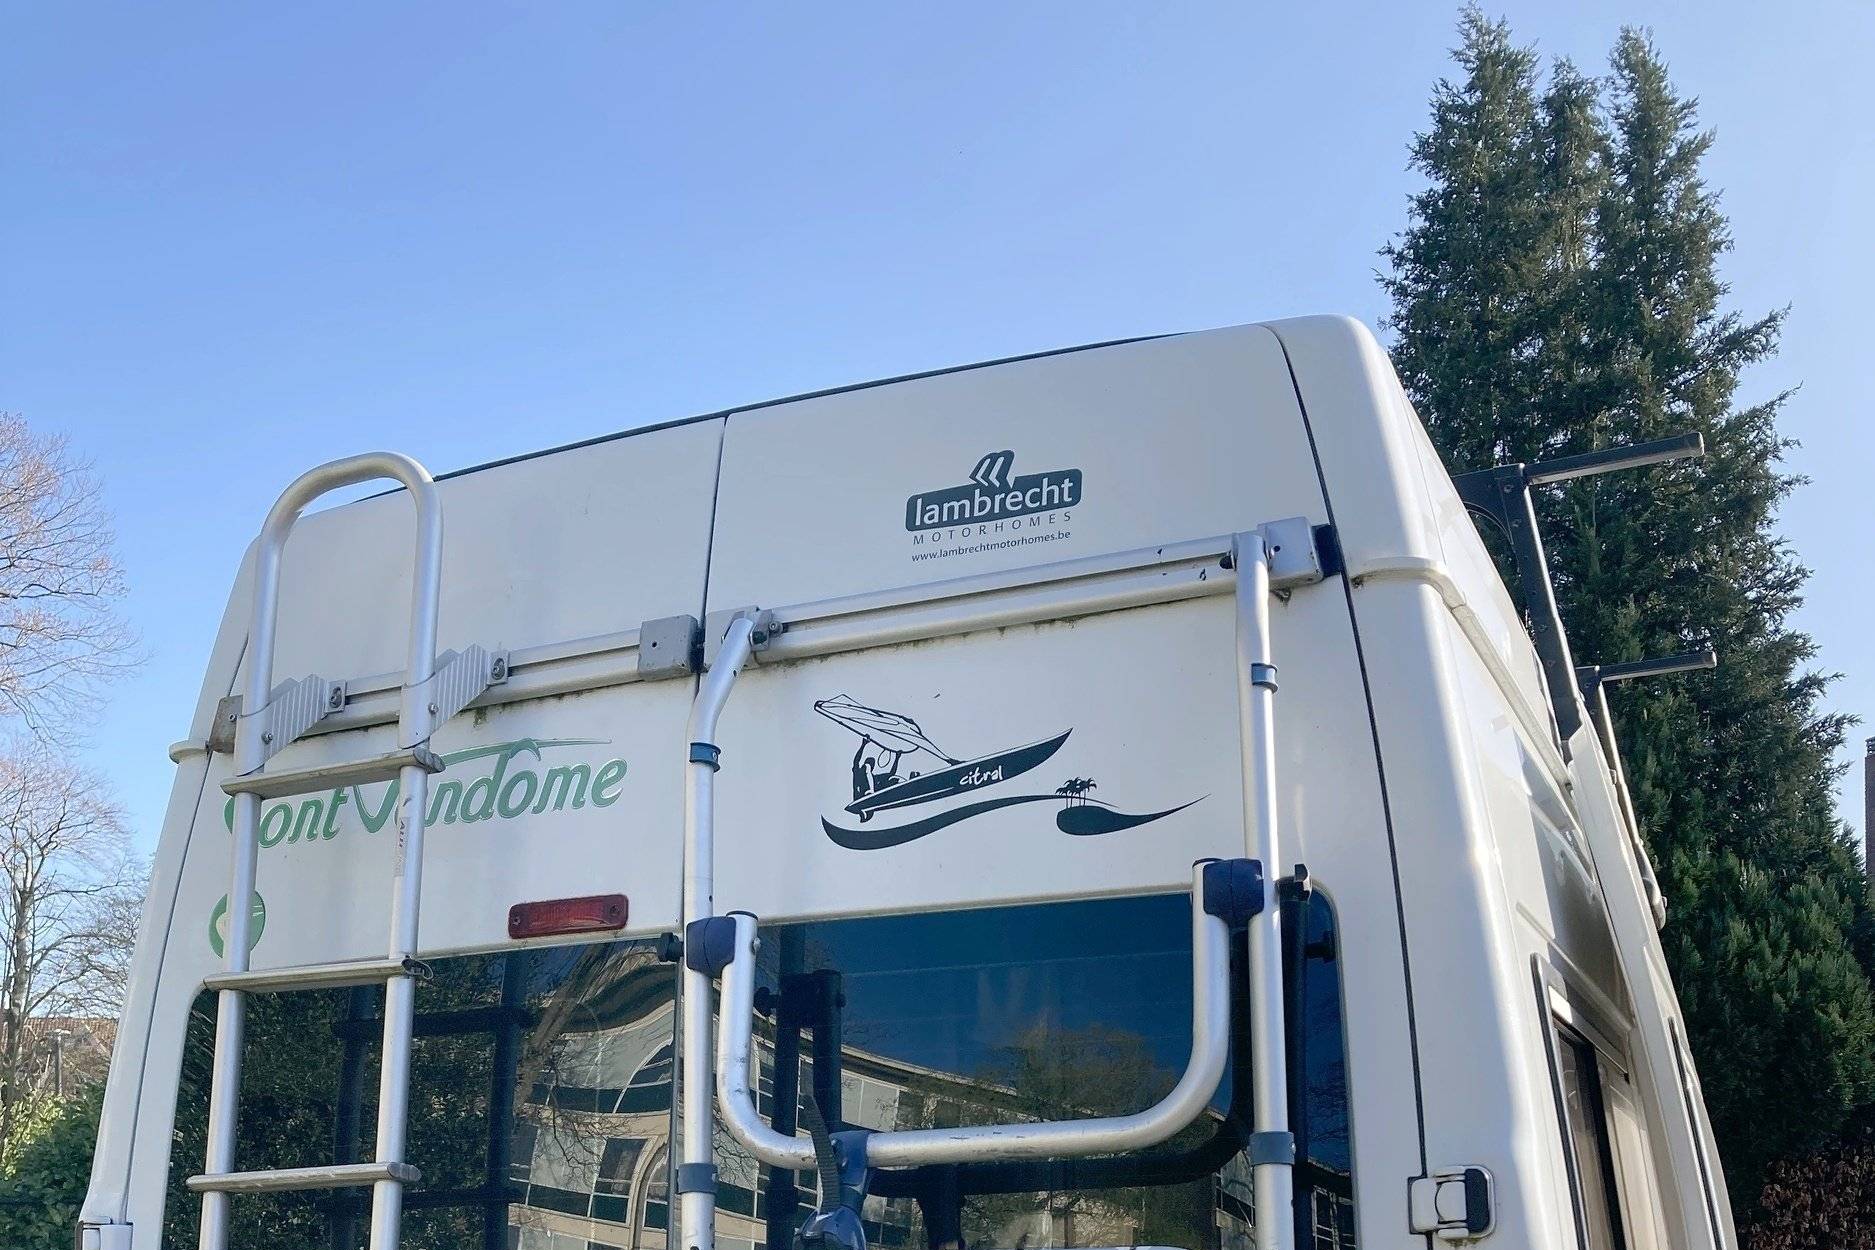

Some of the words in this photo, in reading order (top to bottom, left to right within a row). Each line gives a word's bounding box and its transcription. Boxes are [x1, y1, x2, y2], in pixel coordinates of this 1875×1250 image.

[914, 477, 1073, 526] lambrecht
[913, 511, 1072, 545] MOTORHOMES
[911, 529, 1071, 562] www.lambrechtmotorhomes.be
[959, 765, 1004, 786] citral
